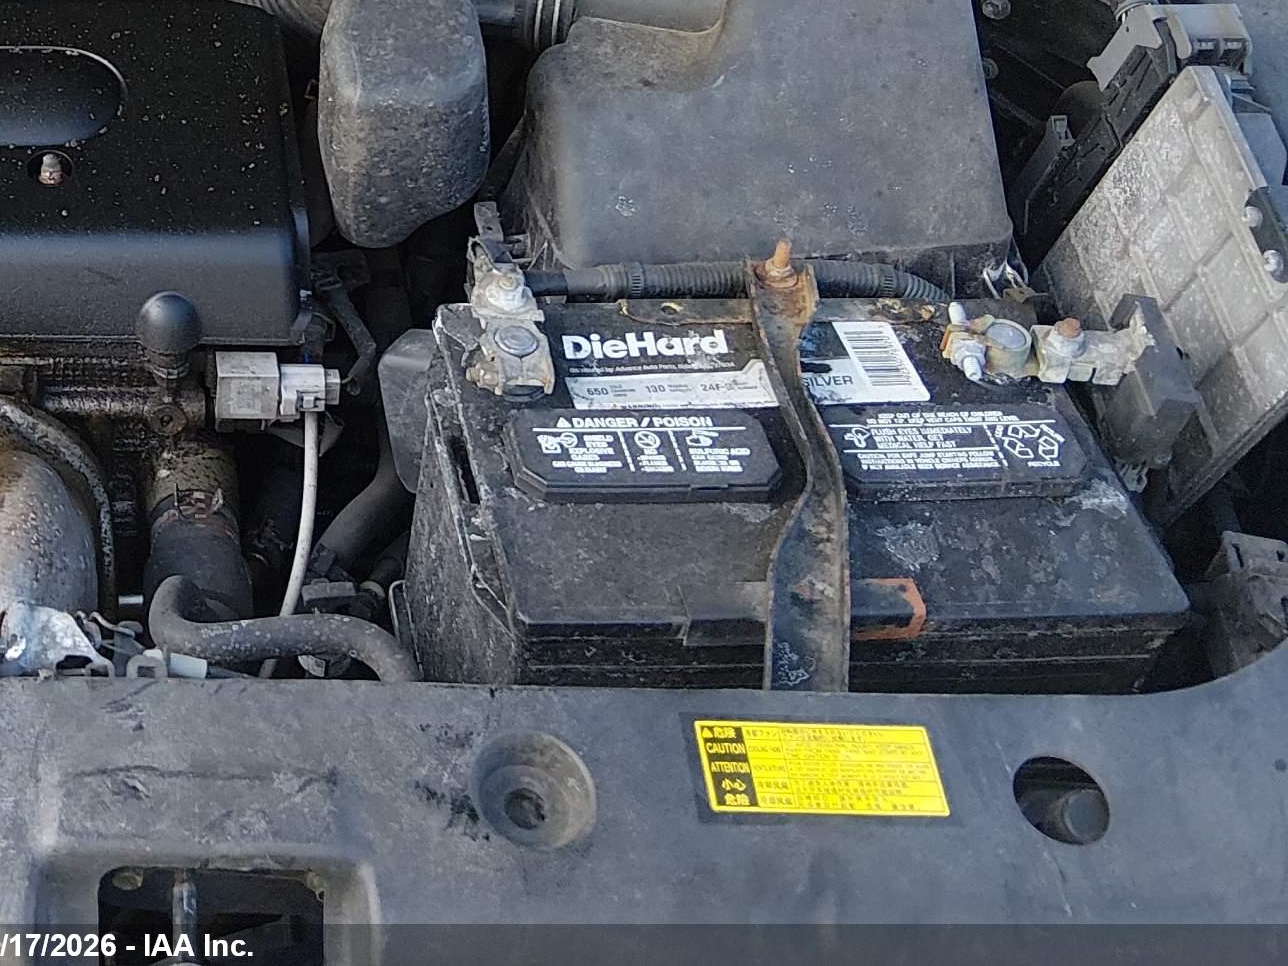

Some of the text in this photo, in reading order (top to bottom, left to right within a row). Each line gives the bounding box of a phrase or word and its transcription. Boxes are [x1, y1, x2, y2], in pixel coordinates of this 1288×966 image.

[562, 330, 729, 360] DieHard
[801, 375, 854, 388] SILVER
[645, 385, 666, 394] 130
[571, 417, 639, 428] DANGER
[652, 416, 713, 427] POISON
[870, 426, 973, 436] FLUSH EYES IMMEDIATELY
[877, 440, 957, 449] MEDICAL HELP FAST
[706, 742, 746, 754] CAUTION
[711, 761, 751, 774] ATTENTION
